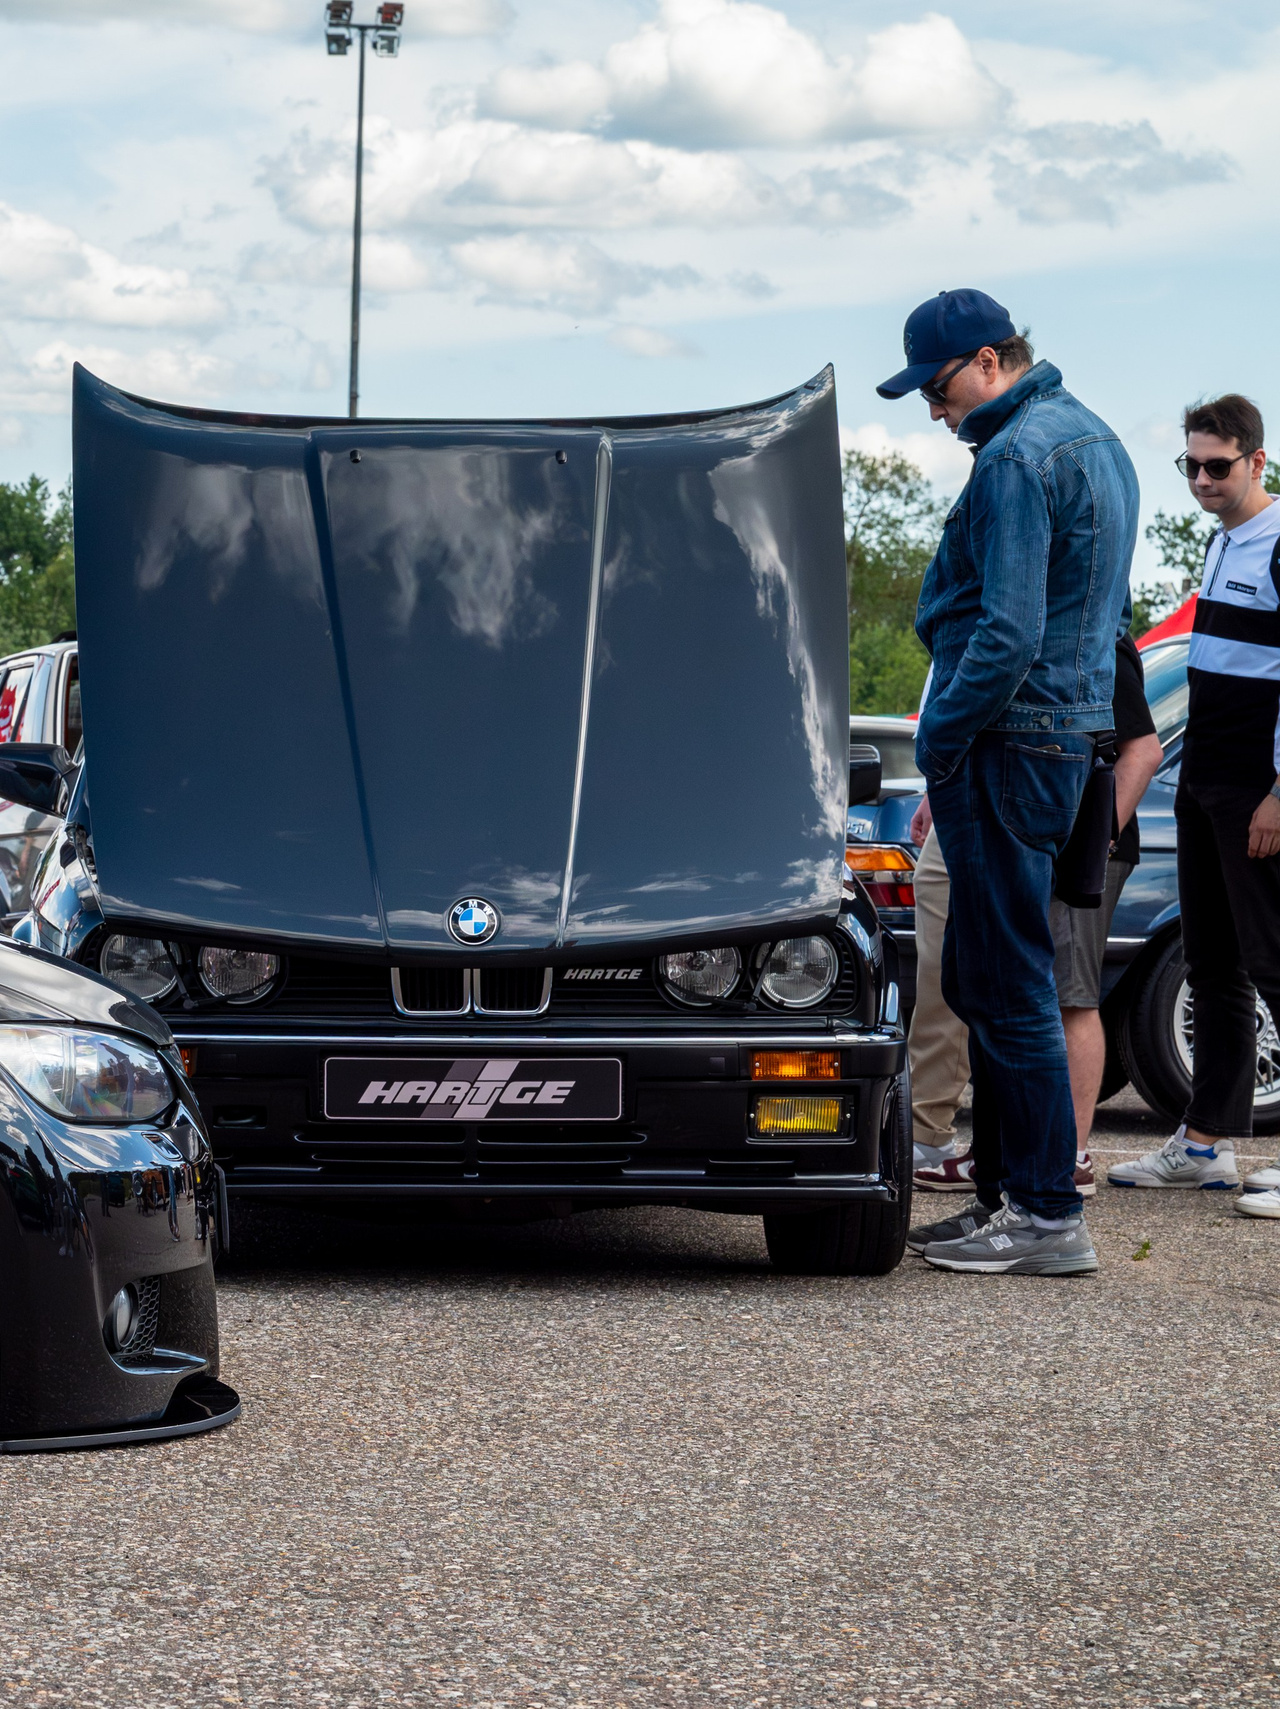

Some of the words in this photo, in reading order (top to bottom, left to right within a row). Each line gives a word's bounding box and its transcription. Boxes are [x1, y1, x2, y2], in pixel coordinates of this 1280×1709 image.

[454, 900, 494, 915] BMW
[563, 968, 643, 980] HARTGE
[357, 1080, 577, 1105] HARTGE
